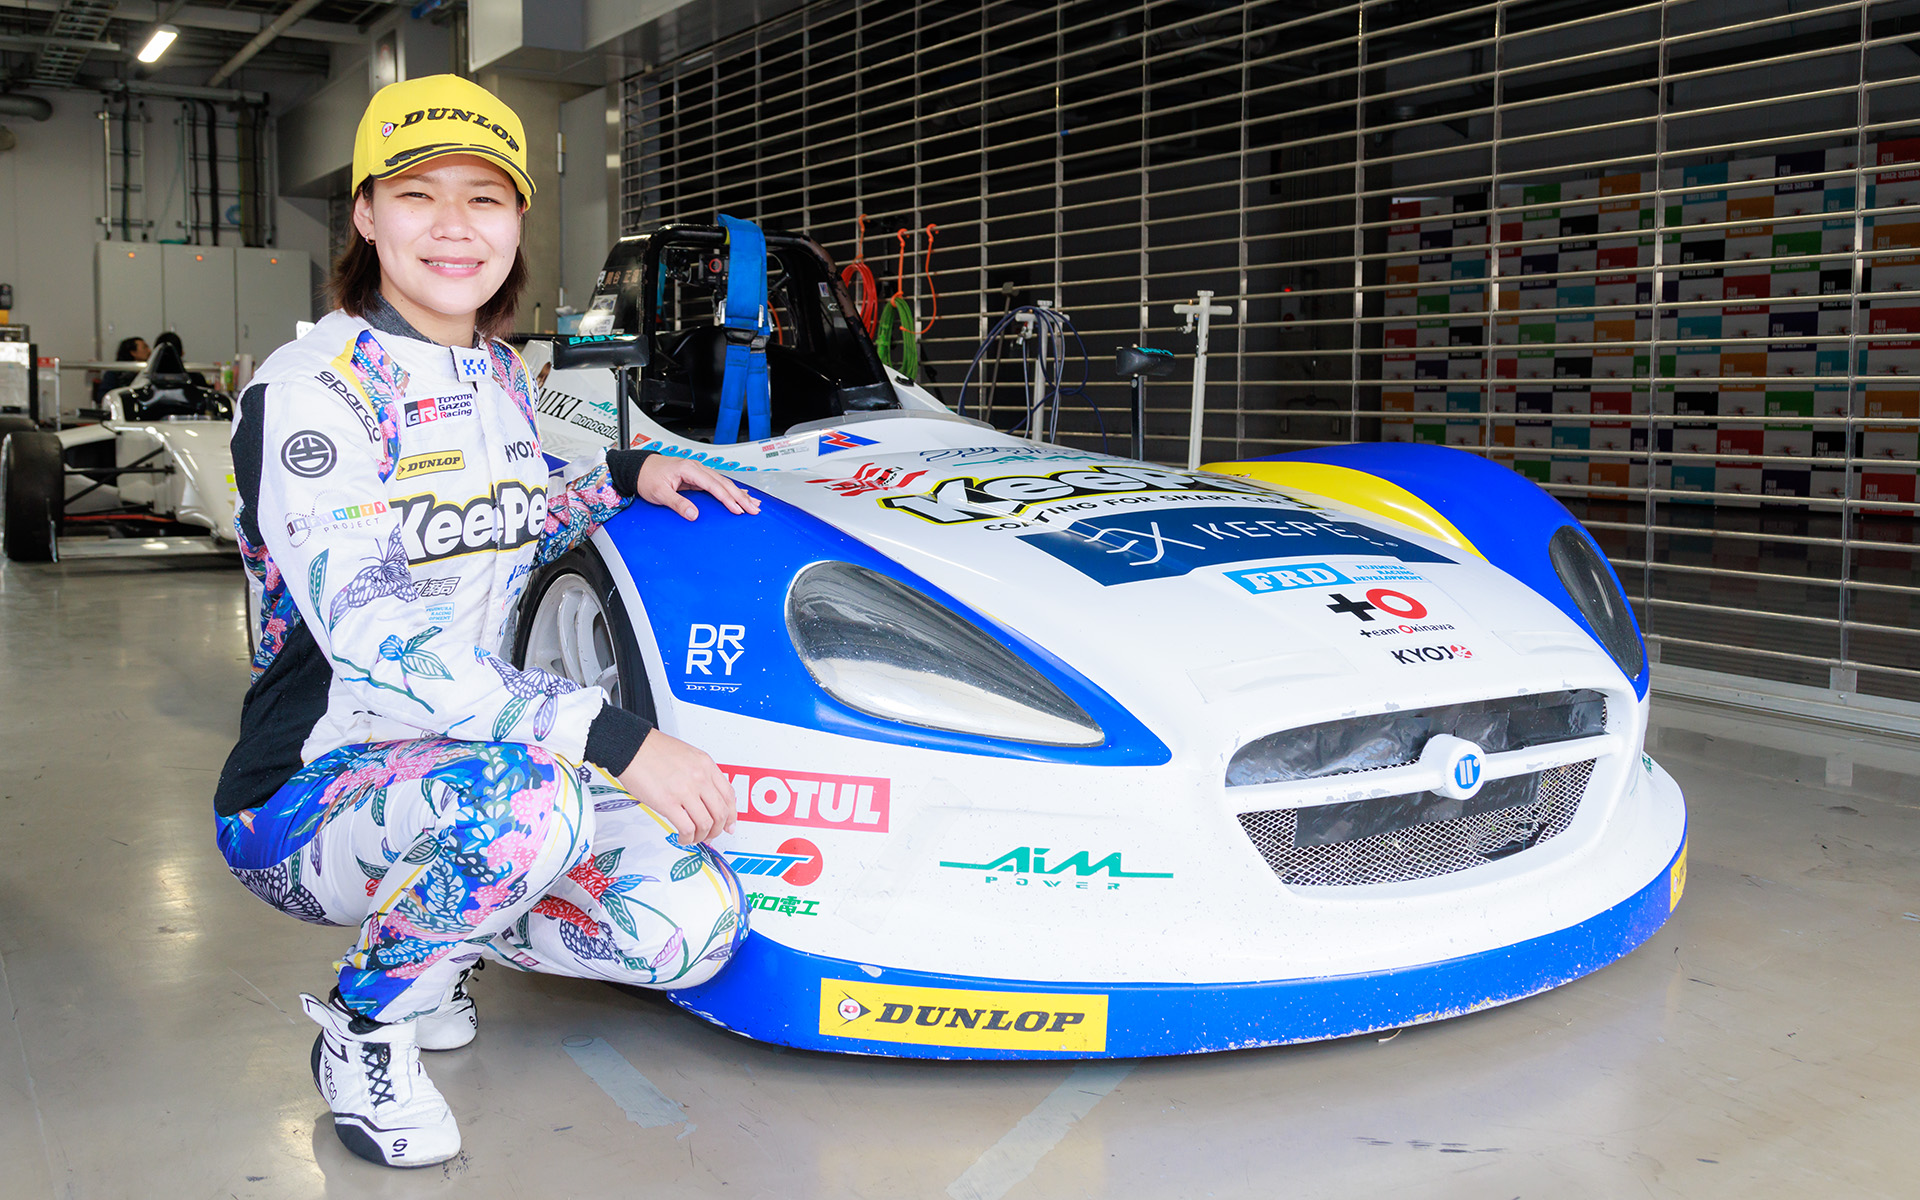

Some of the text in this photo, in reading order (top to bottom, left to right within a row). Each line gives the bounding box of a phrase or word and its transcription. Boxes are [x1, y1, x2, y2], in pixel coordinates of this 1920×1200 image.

[401, 108, 520, 152] DUNLOP
[314, 371, 382, 444] sparco
[436, 394, 473, 404] TOYOTA
[438, 402, 472, 412] GAZOO
[406, 406, 438, 426] GR
[440, 408, 472, 418] Racing
[407, 457, 461, 472] DUNLOP
[984, 502, 1098, 531] COATING
[1102, 496, 1154, 506] FOR
[1159, 495, 1239, 503] SMART
[324, 517, 380, 533] PROJECT
[389, 486, 548, 561] KeePe
[1241, 566, 1338, 591] FRD
[688, 624, 746, 650] DR
[1398, 622, 1455, 634] Okinawa
[686, 649, 745, 676] RY
[710, 685, 740, 693] Dry
[985, 876, 1120, 890] POWER
[875, 1002, 1086, 1033] DUNLOP
